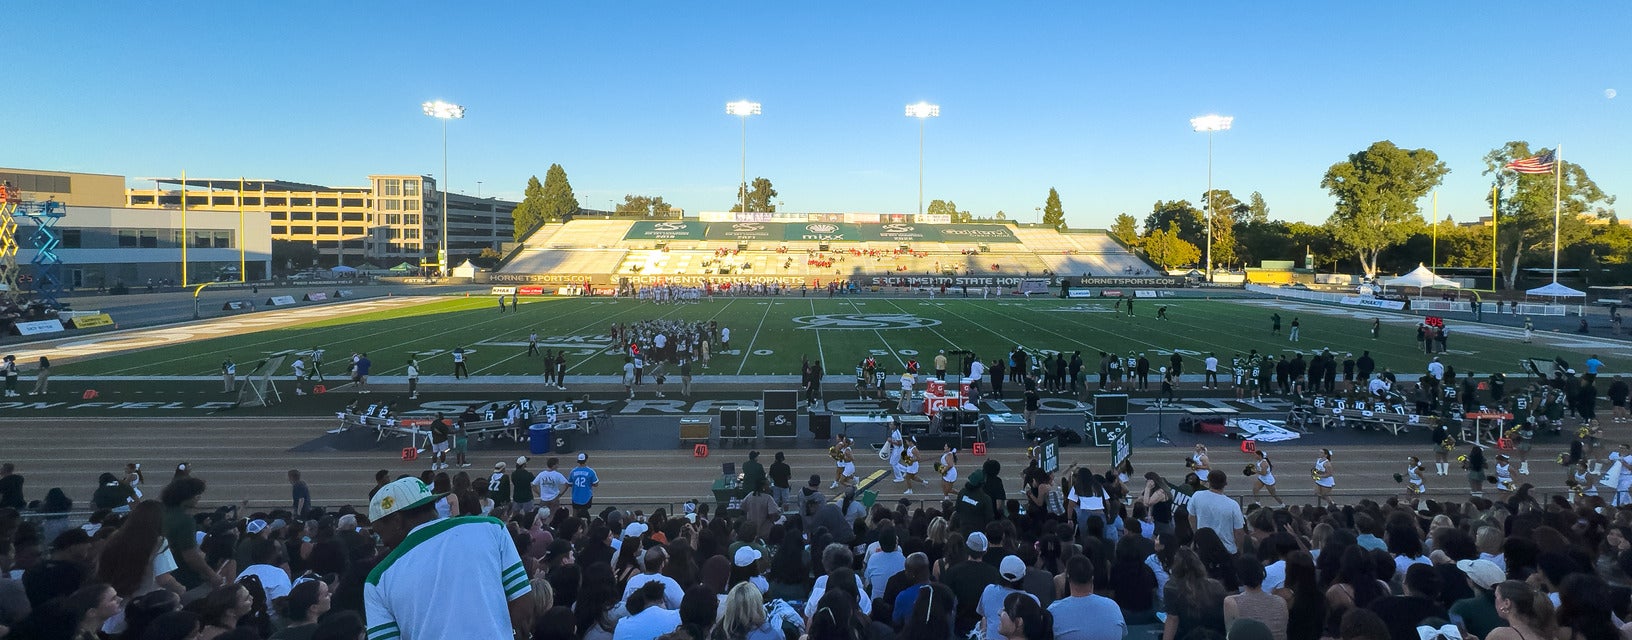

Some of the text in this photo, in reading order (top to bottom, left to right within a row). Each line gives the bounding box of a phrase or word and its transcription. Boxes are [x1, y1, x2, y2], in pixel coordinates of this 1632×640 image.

[490, 274, 592, 282] HORNETSPORTS.COM
[955, 277, 992, 285] STATE
[996, 277, 1051, 285] HORS
[520, 401, 530, 411] 14
[1313, 398, 1325, 408] 82
[695, 446, 706, 456] 40
[975, 444, 985, 454] 50
[1245, 441, 1256, 452] 40
[403, 448, 415, 459] 30
[574, 477, 587, 488] 42
